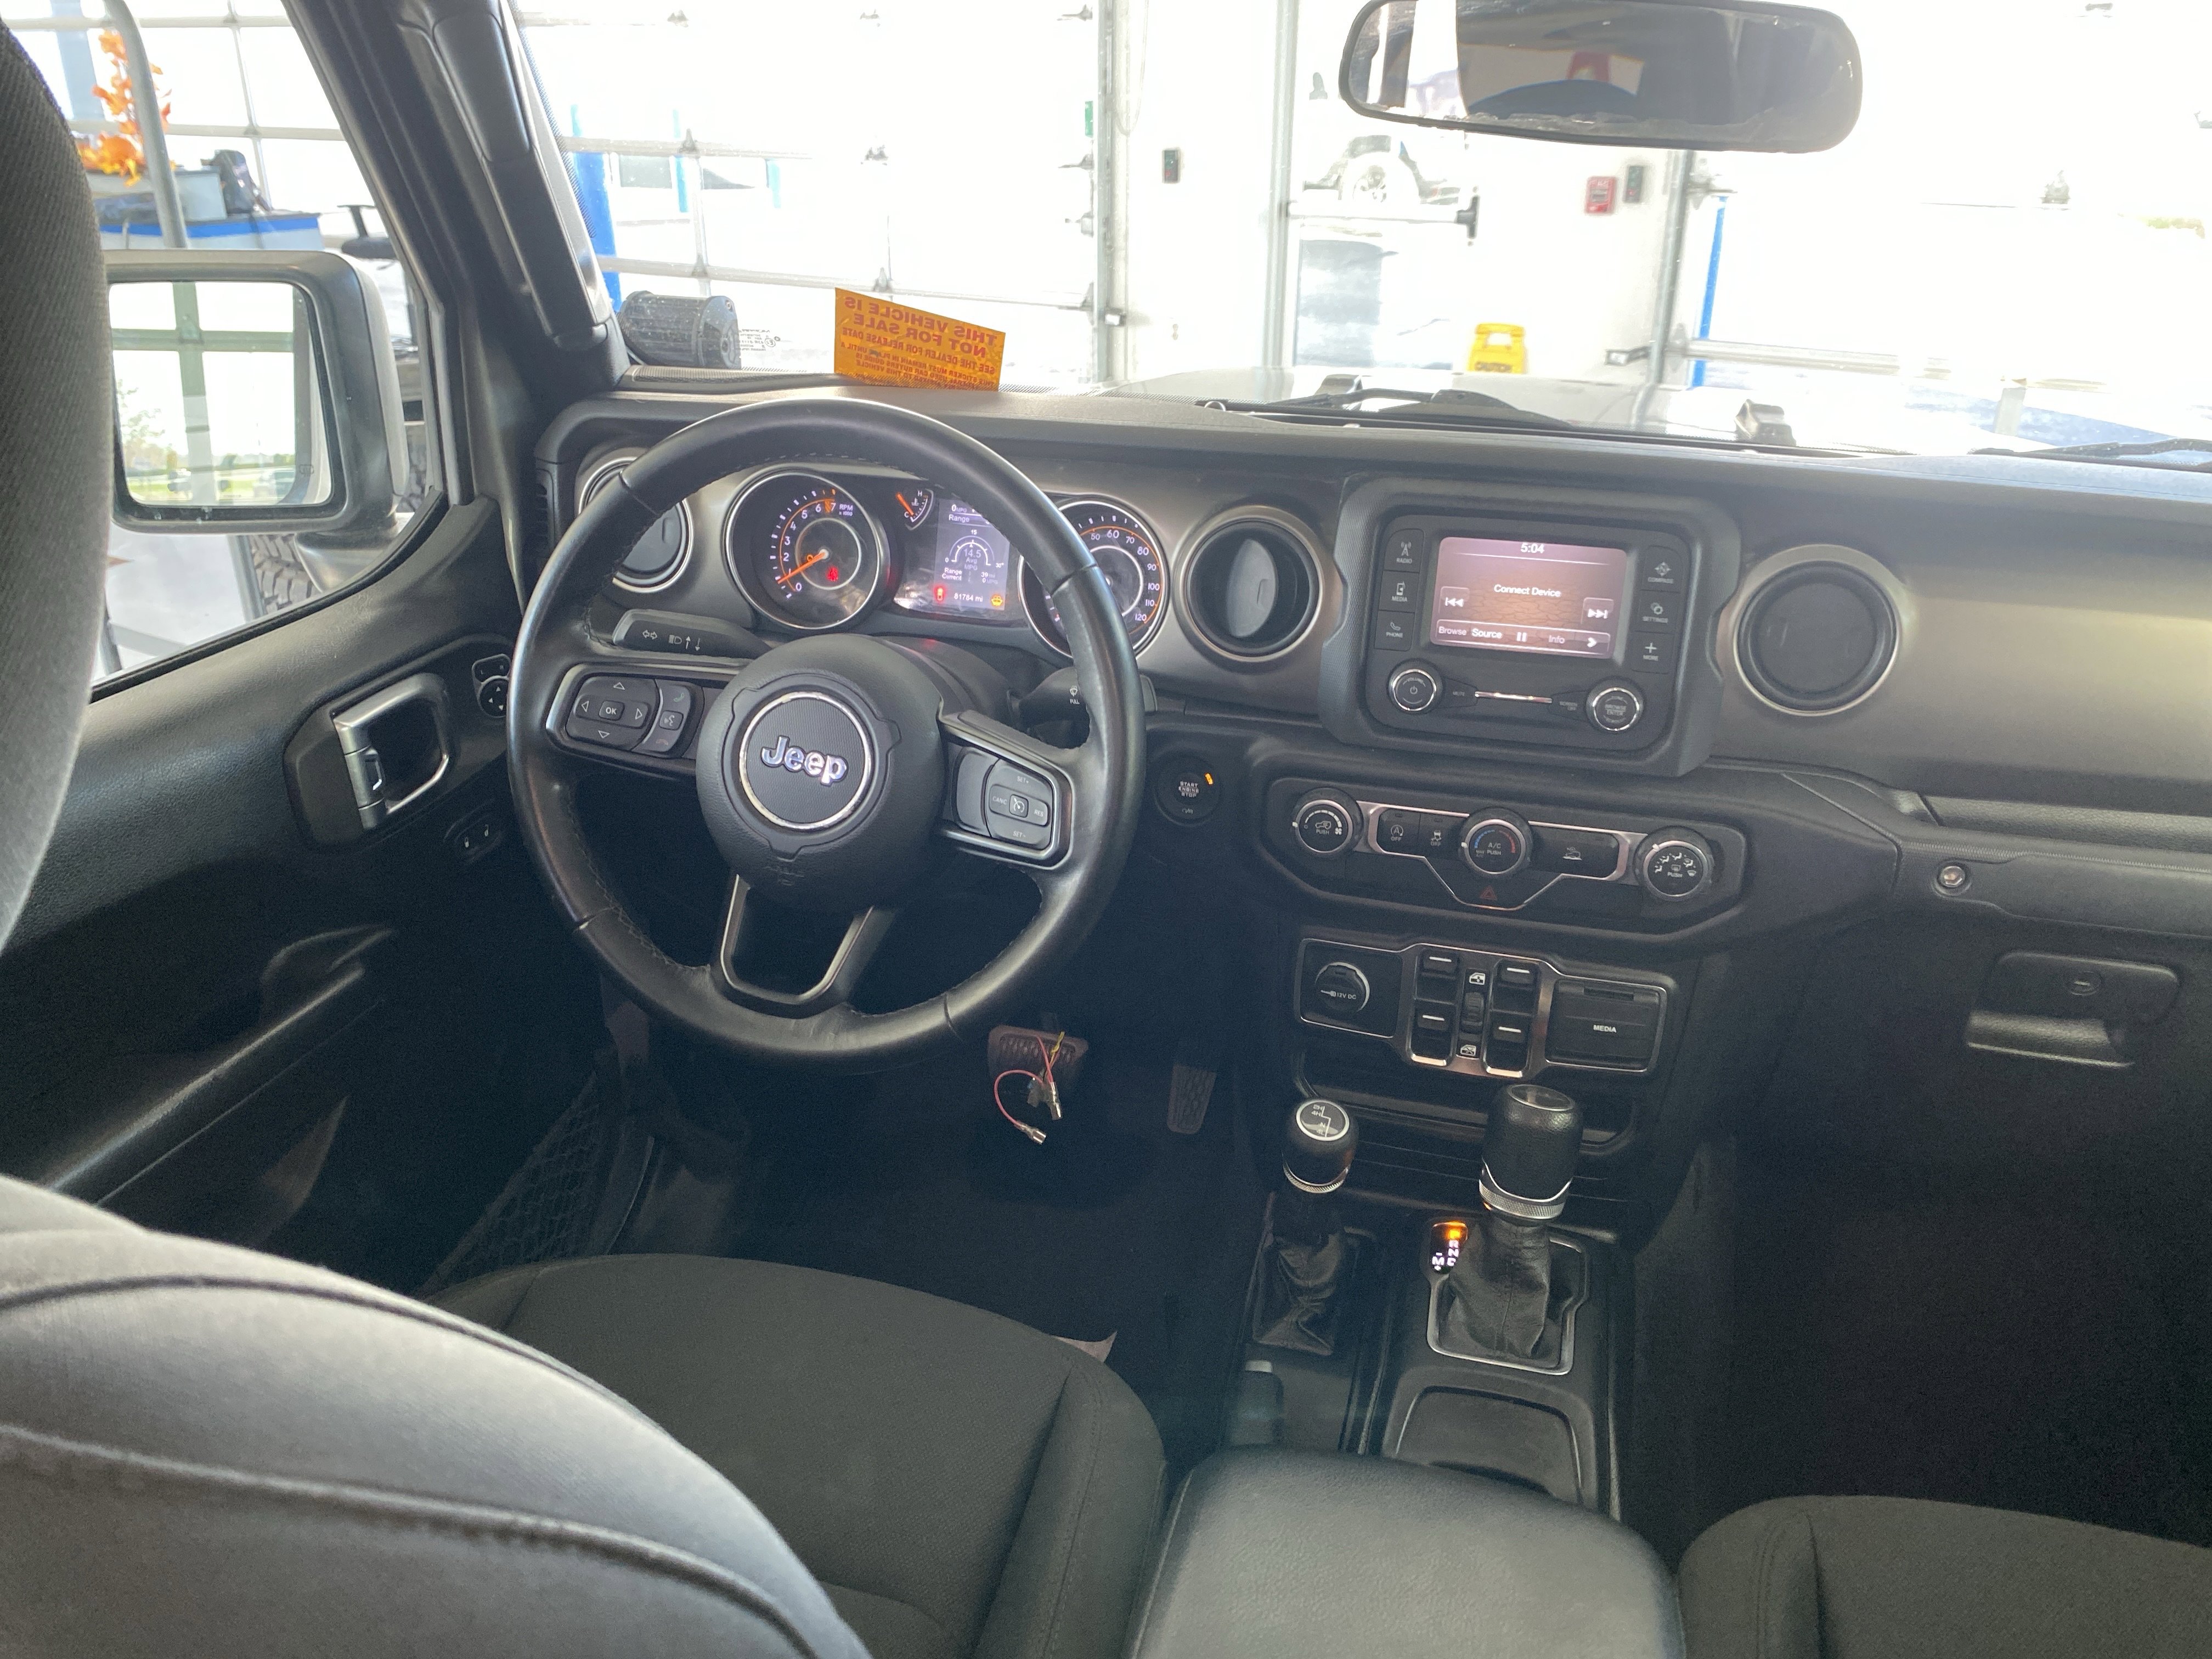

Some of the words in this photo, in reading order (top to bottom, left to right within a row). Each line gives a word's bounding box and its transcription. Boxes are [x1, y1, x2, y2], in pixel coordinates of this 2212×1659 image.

[815, 504, 821, 512] 6
[831, 502, 837, 512] 7
[802, 510, 808, 519] 5
[949, 514, 969, 523] Range
[790, 522, 796, 531] 4
[1107, 530, 1119, 539] 60
[785, 536, 790, 545] 3
[1137, 546, 1149, 556] 80
[1521, 543, 1544, 554] 5:04
[783, 552, 789, 562] 2
[964, 549, 981, 558] 14.5
[945, 567, 962, 575] Range
[795, 583, 802, 591] 0
[1148, 583, 1160, 591] 100
[1493, 584, 1530, 595] Connect
[1531, 587, 1561, 597] Device
[1438, 626, 1467, 636] Browse
[1471, 628, 1503, 639] Source
[1549, 635, 1565, 644] Info
[761, 736, 848, 786] Jeep
[992, 797, 1007, 805] CANC
[1593, 1024, 1617, 1033] MEDIA
[1449, 1240, 1459, 1248] R
[1448, 1248, 1459, 1258] N
[1432, 1256, 1444, 1266] M
